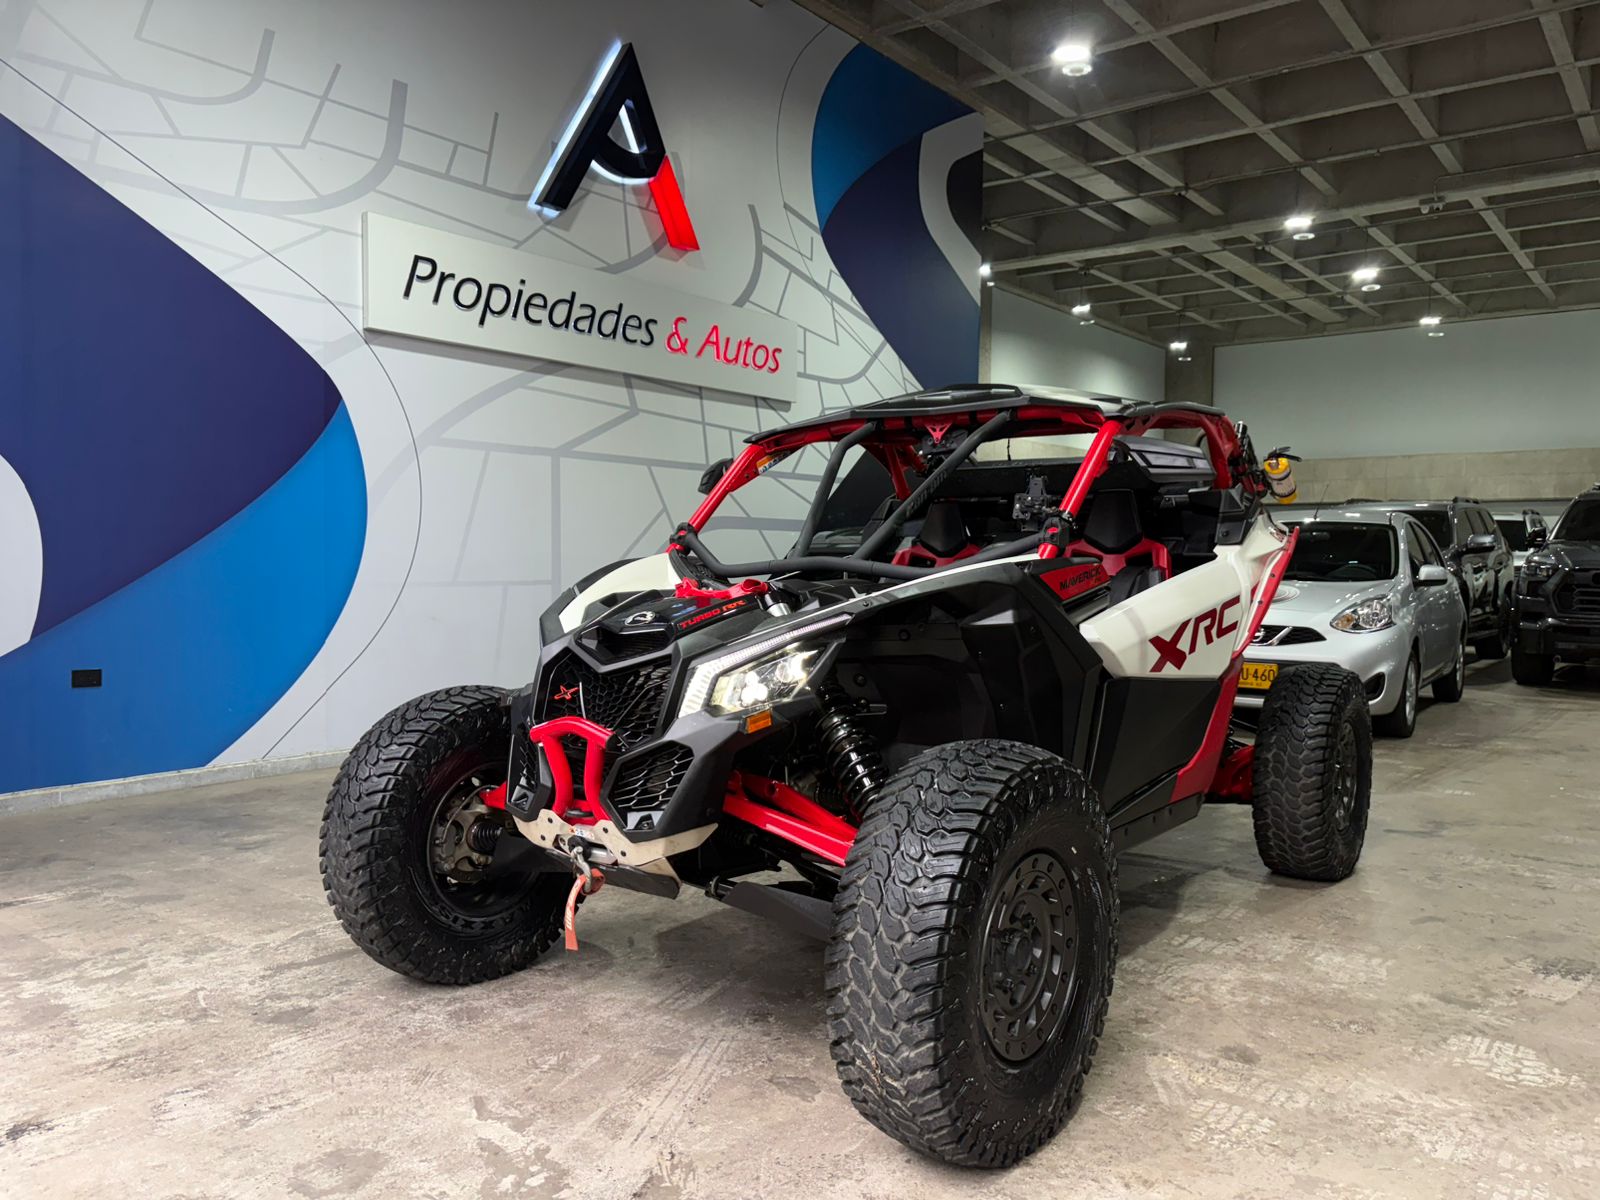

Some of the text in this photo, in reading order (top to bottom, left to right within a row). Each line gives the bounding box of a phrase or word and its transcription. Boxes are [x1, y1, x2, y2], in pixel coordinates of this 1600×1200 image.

[402, 255, 783, 374] Propiedades & Autos
[1059, 566, 1102, 591] MAVERICK
[680, 608, 721, 629] TURBO
[1147, 594, 1241, 674] XRC
